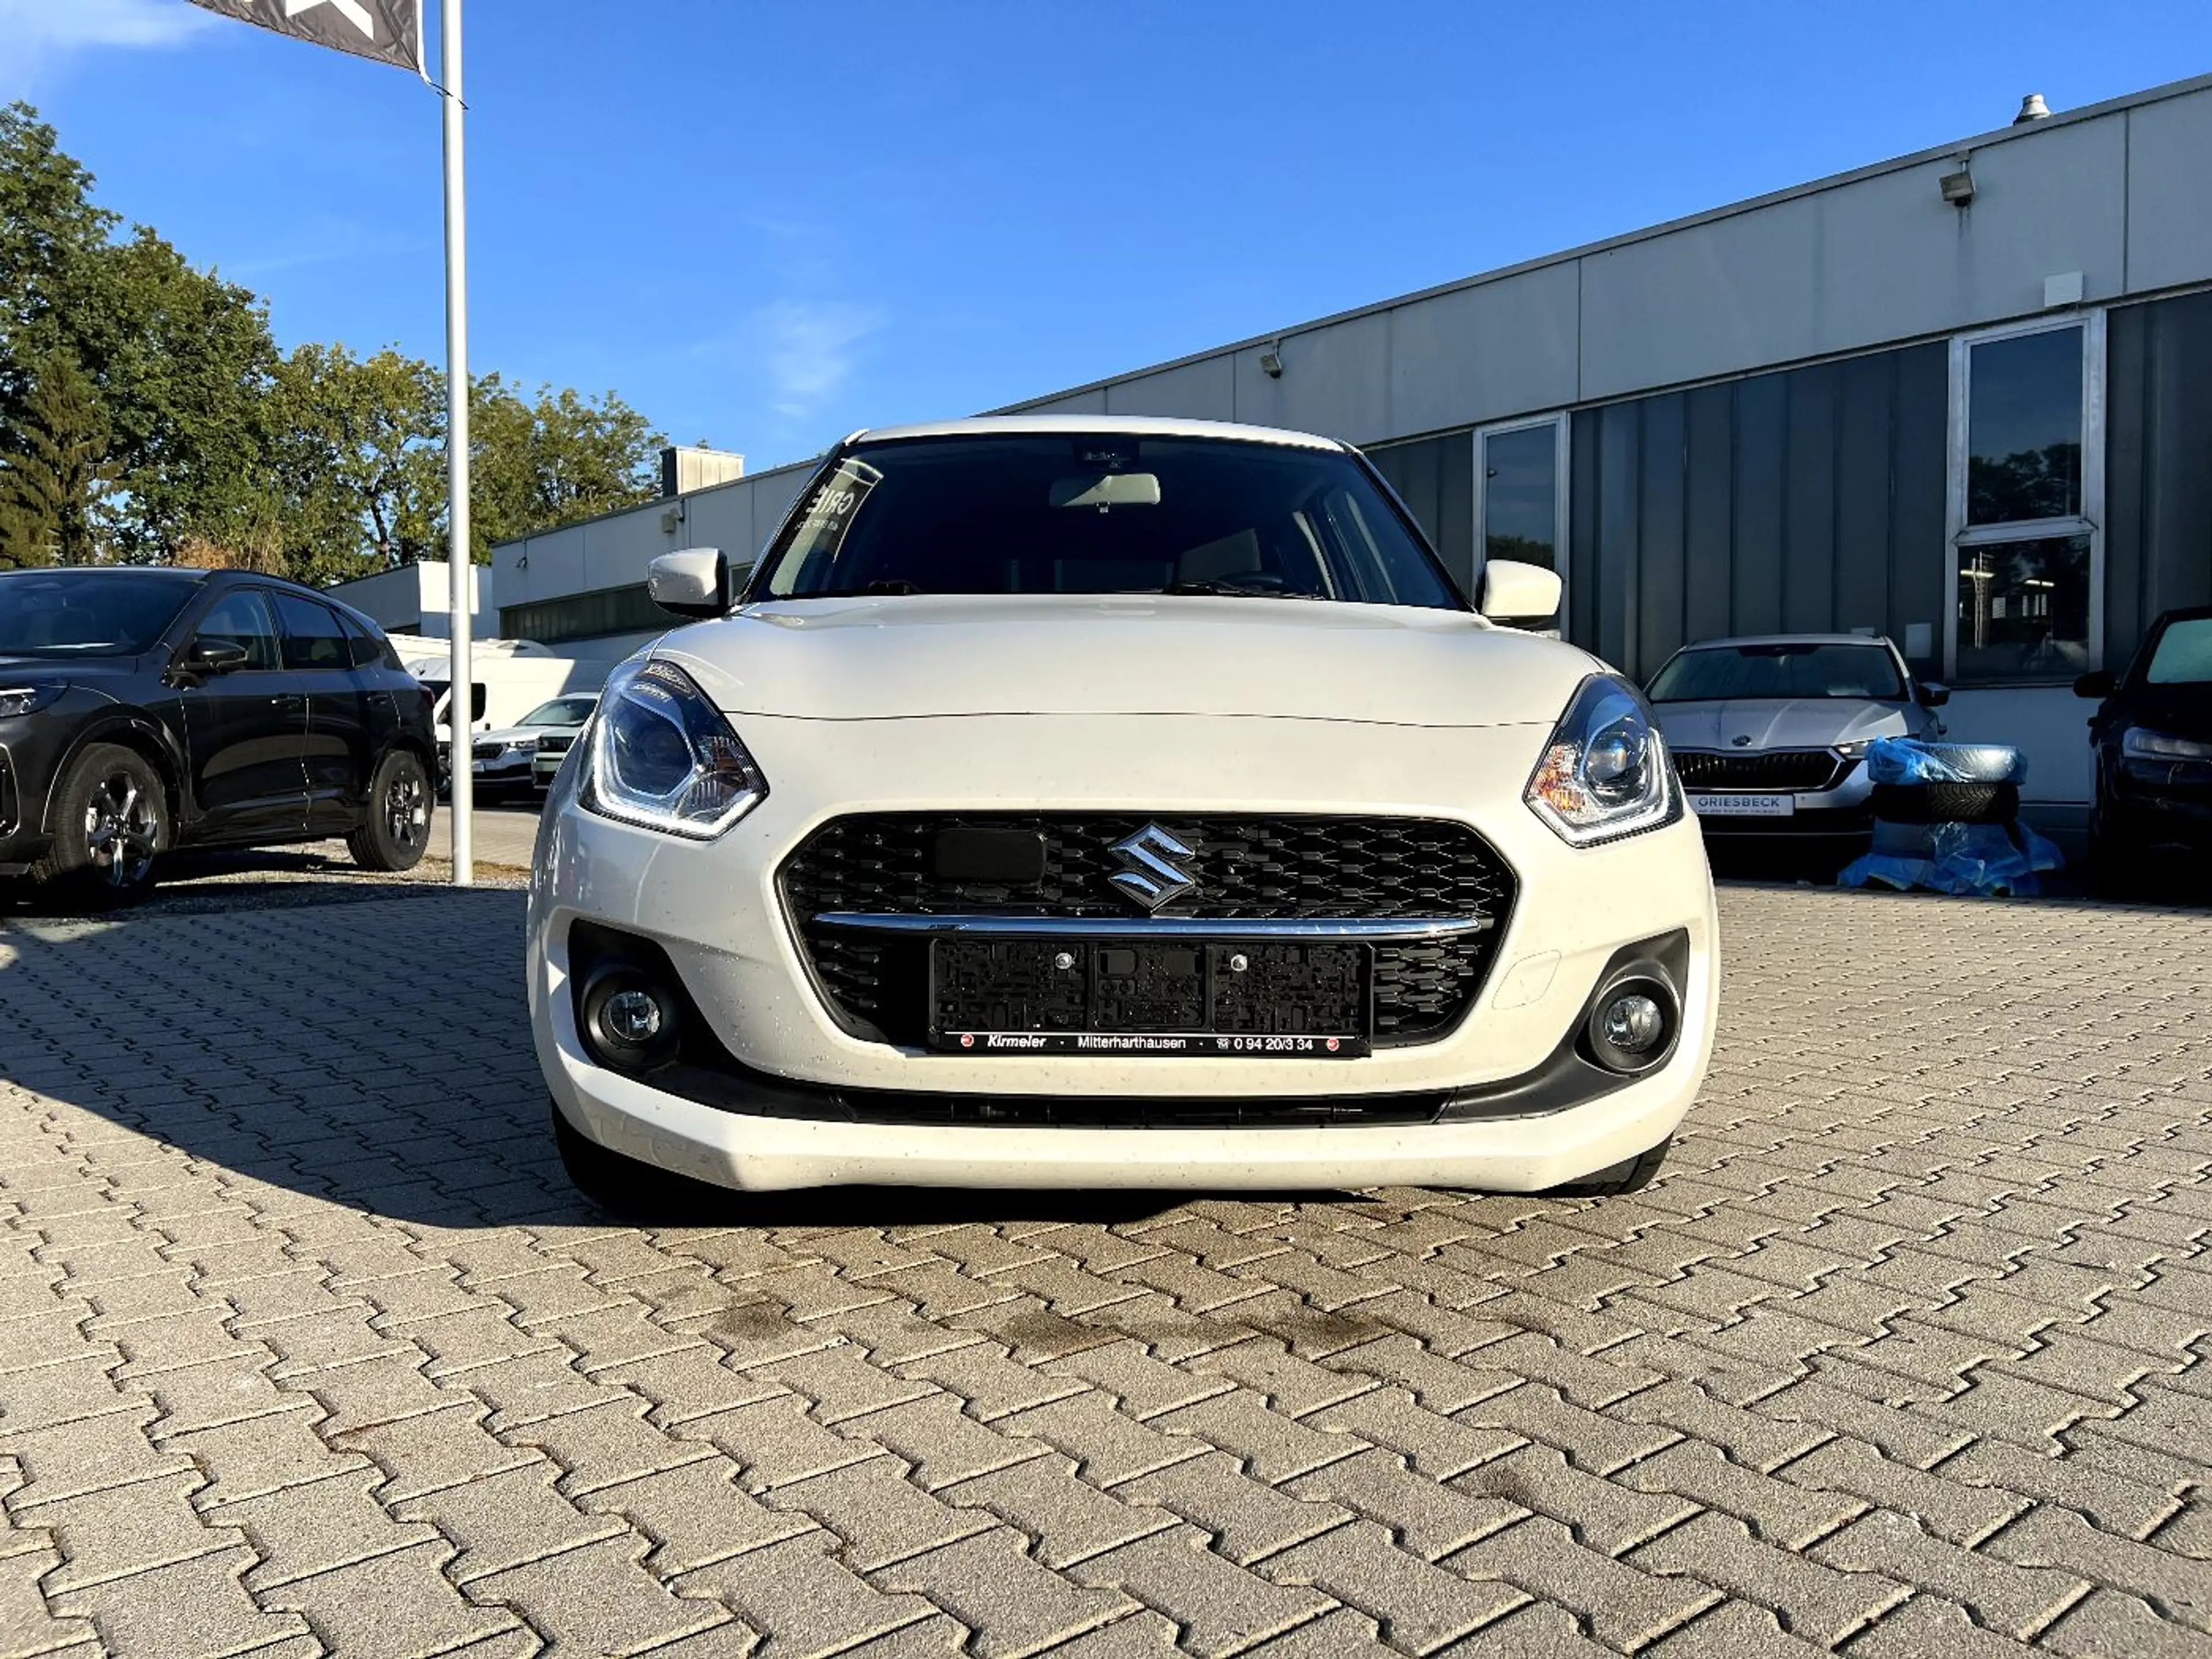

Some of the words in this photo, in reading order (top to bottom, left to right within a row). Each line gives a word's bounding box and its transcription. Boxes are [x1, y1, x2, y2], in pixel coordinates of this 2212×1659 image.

[1698, 796, 1781, 807] GRIESBECK
[987, 1034, 1047, 1047] Kirmeler
[1077, 1036, 1186, 1049] Mitterharthausen
